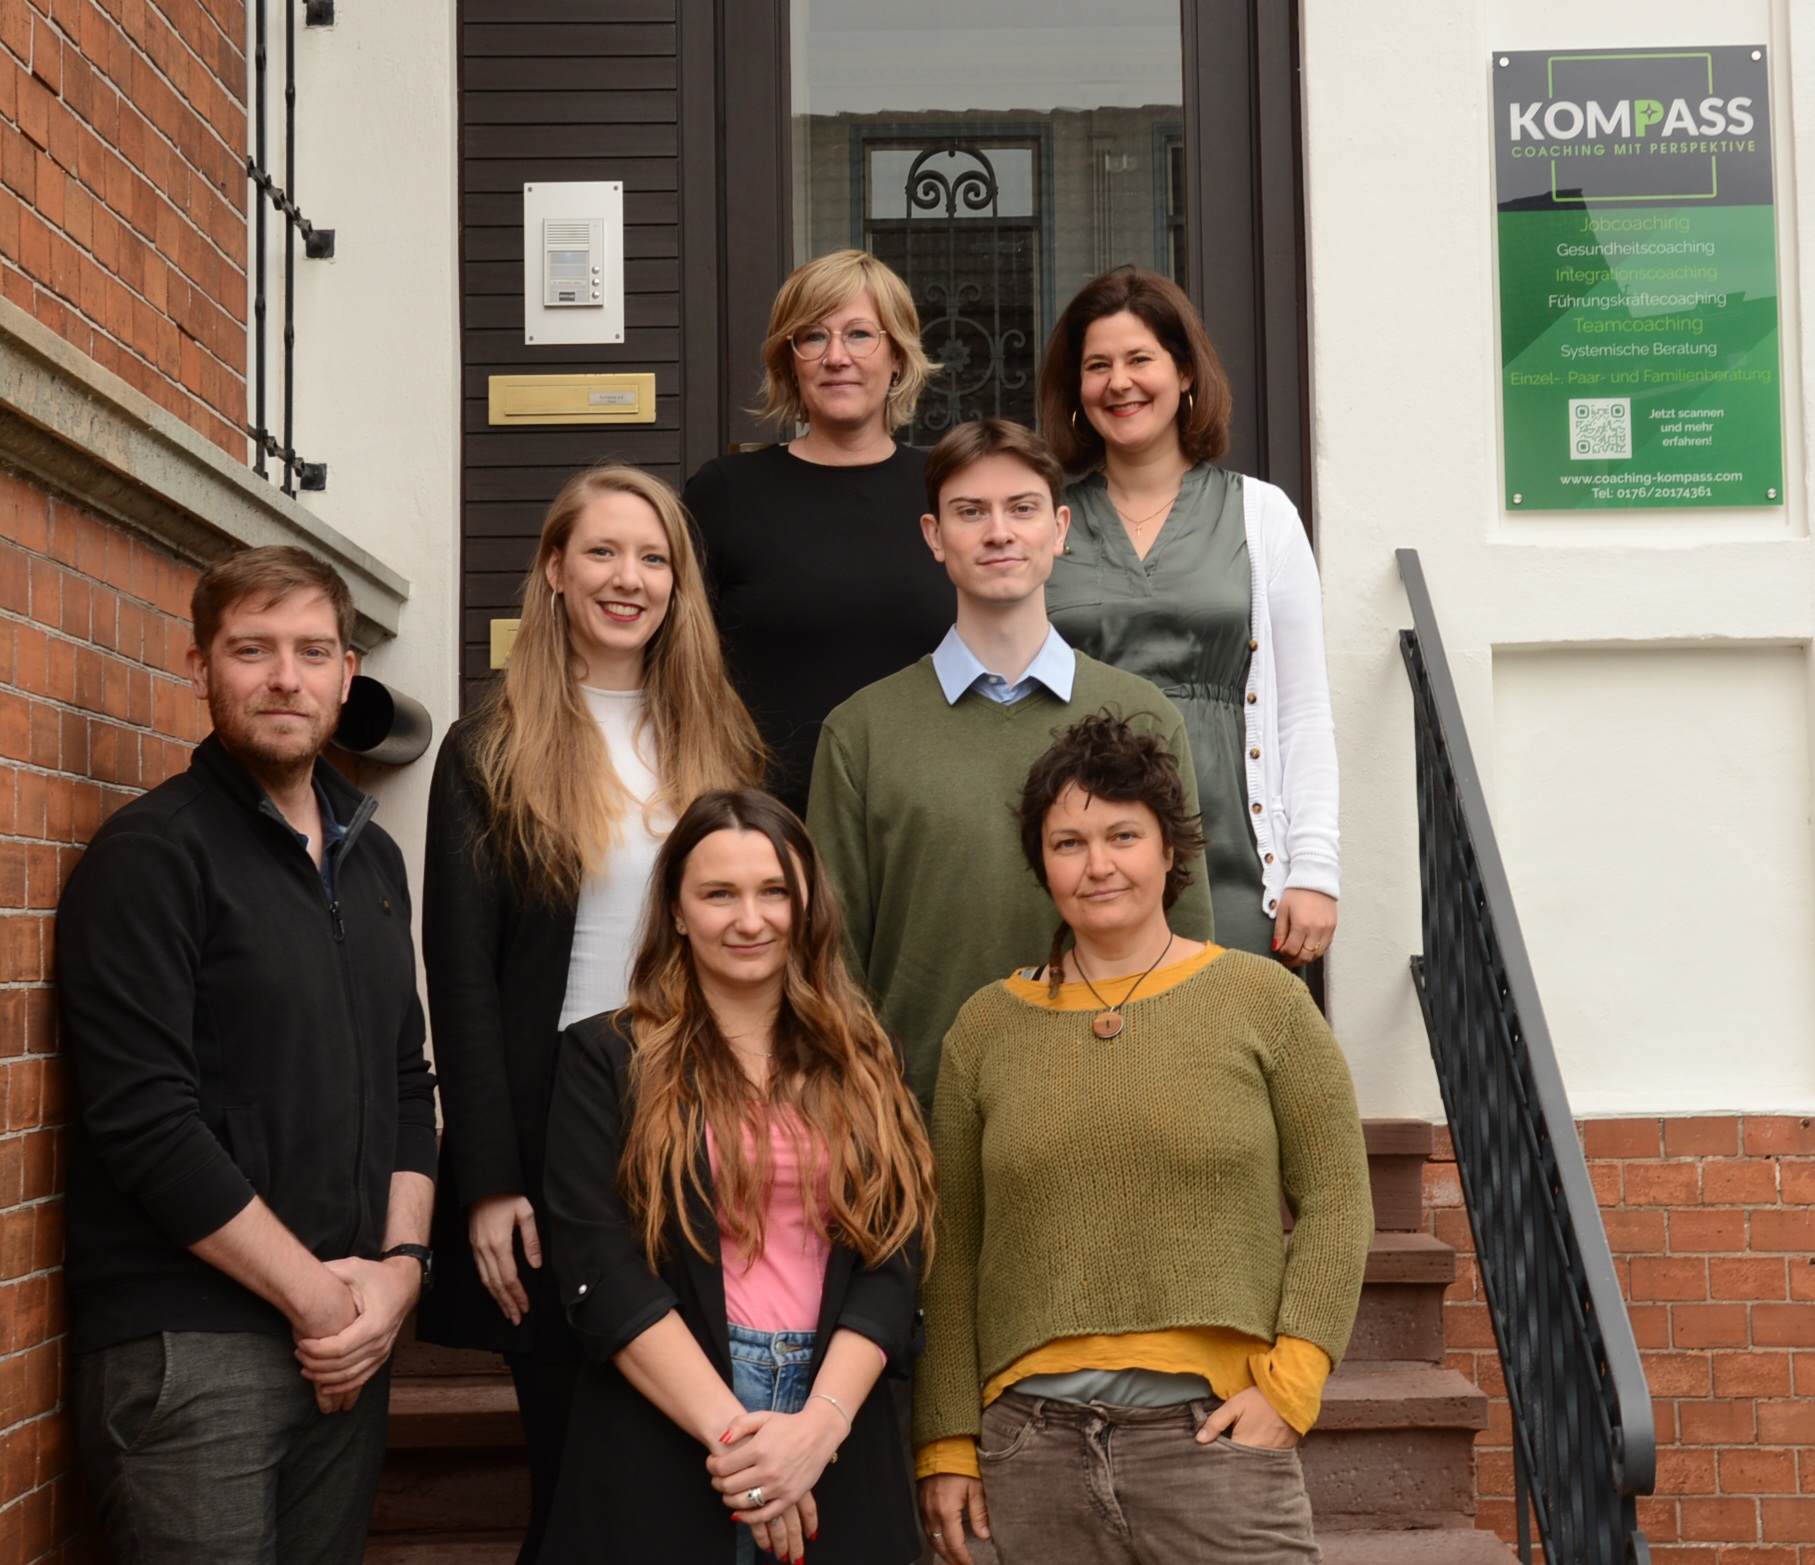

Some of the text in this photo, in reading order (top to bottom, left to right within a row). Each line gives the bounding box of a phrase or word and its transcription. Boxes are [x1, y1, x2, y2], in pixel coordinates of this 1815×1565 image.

[1510, 97, 1754, 141] KOMPASS
[1511, 140, 1757, 158] COACHING MIT PERSPEKTIVE
[1580, 214, 1690, 233] Jobcoaching
[1556, 240, 1715, 257] Gesundheitscoaching
[1555, 265, 1718, 284] Integrationscoaching
[1548, 291, 1727, 310] Führungskräftecoaching
[1573, 316, 1704, 335] Teamcoaching
[1560, 342, 1718, 360] Systemische Beratung
[1569, 371, 1605, 384] Paar-
[1611, 370, 1640, 383] und
[1643, 368, 1772, 384] Familienberatung
[1648, 408, 1724, 419] Jetzt scannen
[1660, 422, 1714, 432] und mehr
[1662, 436, 1713, 446] erfahren!
[1560, 471, 1743, 486] www.coaching-kompass.com
